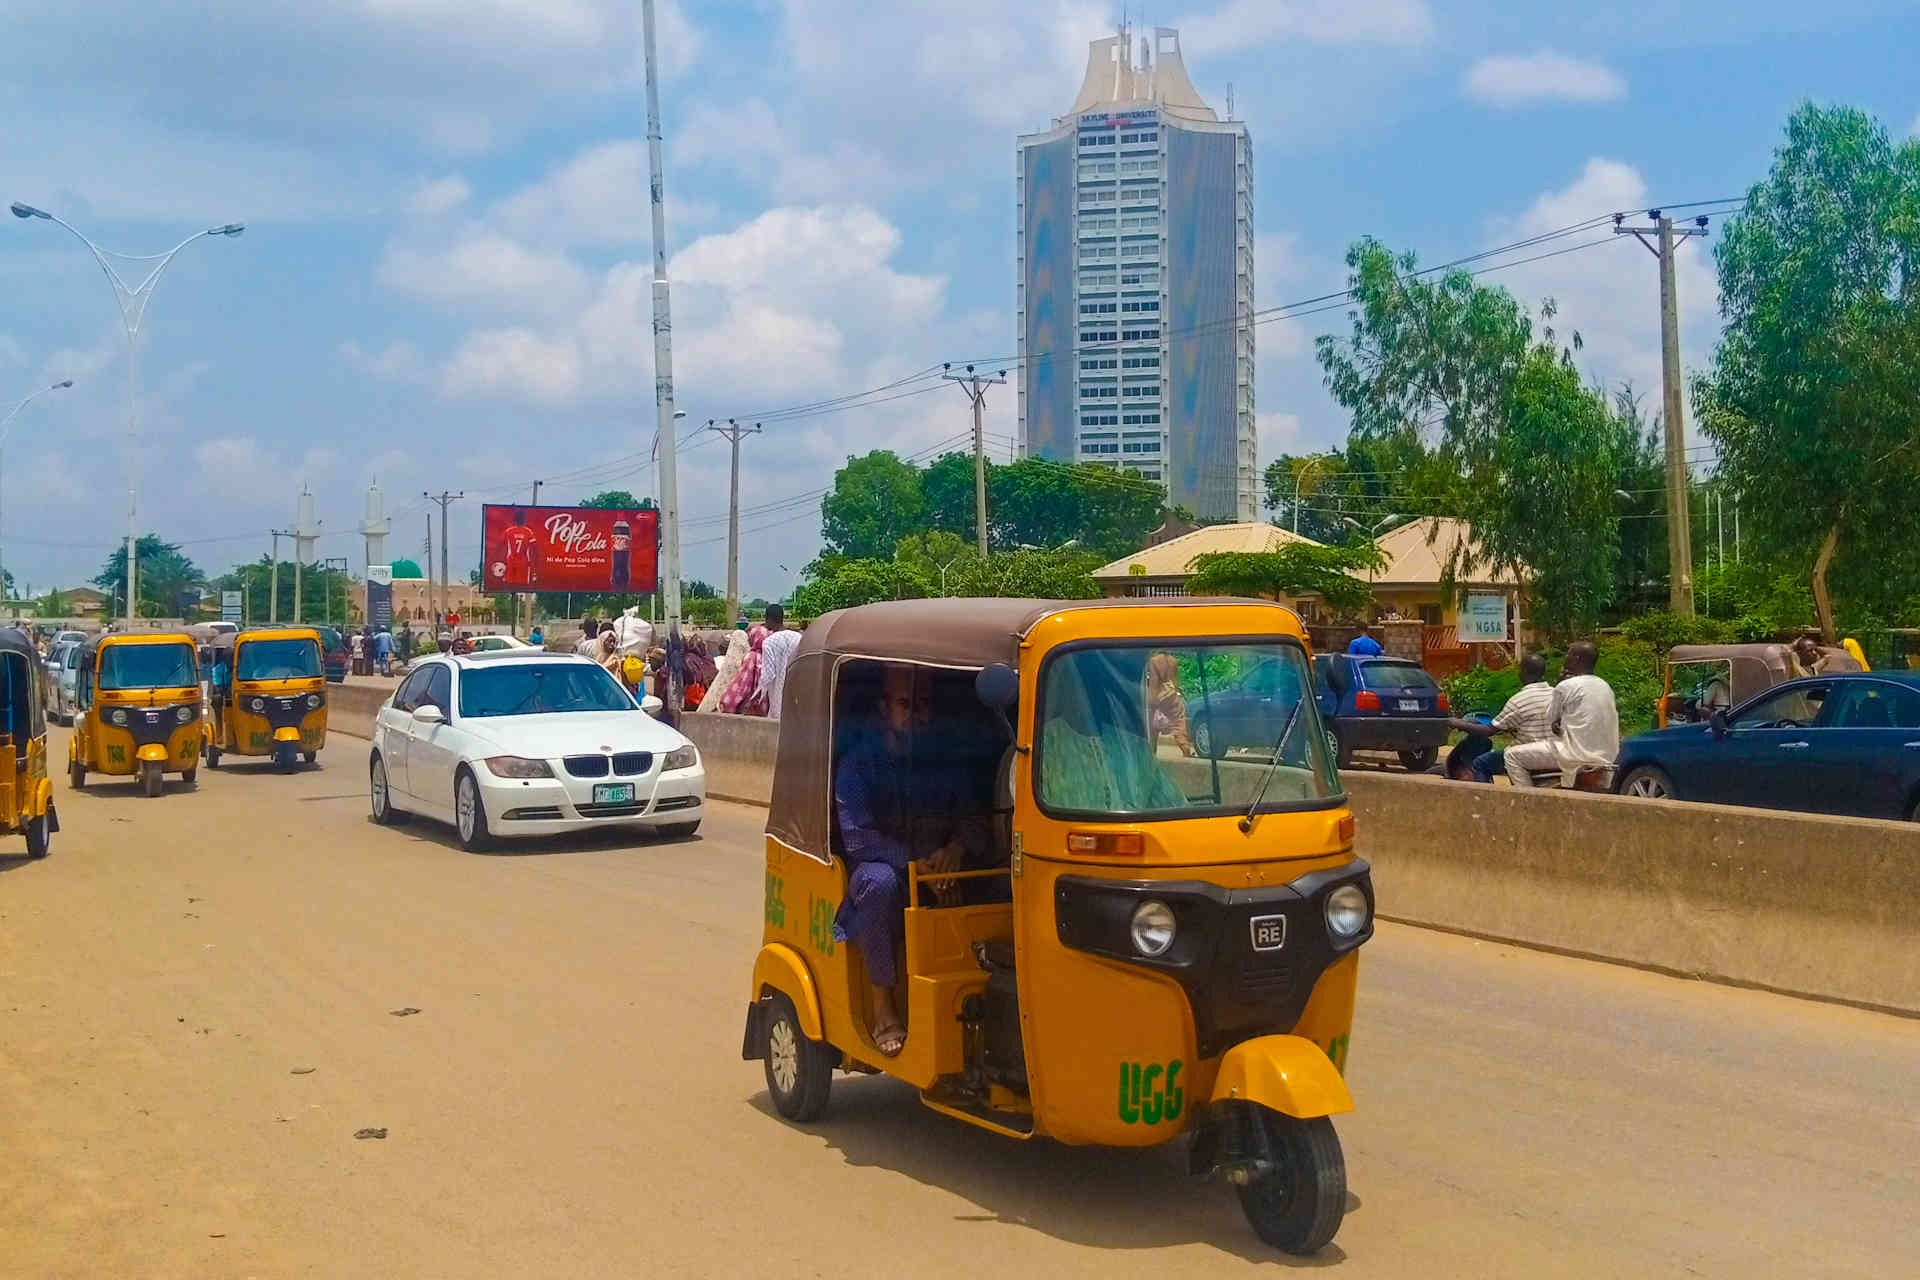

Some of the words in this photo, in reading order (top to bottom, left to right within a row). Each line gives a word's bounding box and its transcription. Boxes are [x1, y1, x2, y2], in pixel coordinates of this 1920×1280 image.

[545, 513, 586, 552] Pop
[515, 540, 523, 552] 7
[575, 532, 607, 553] Cola
[1258, 926, 1281, 944] RE
